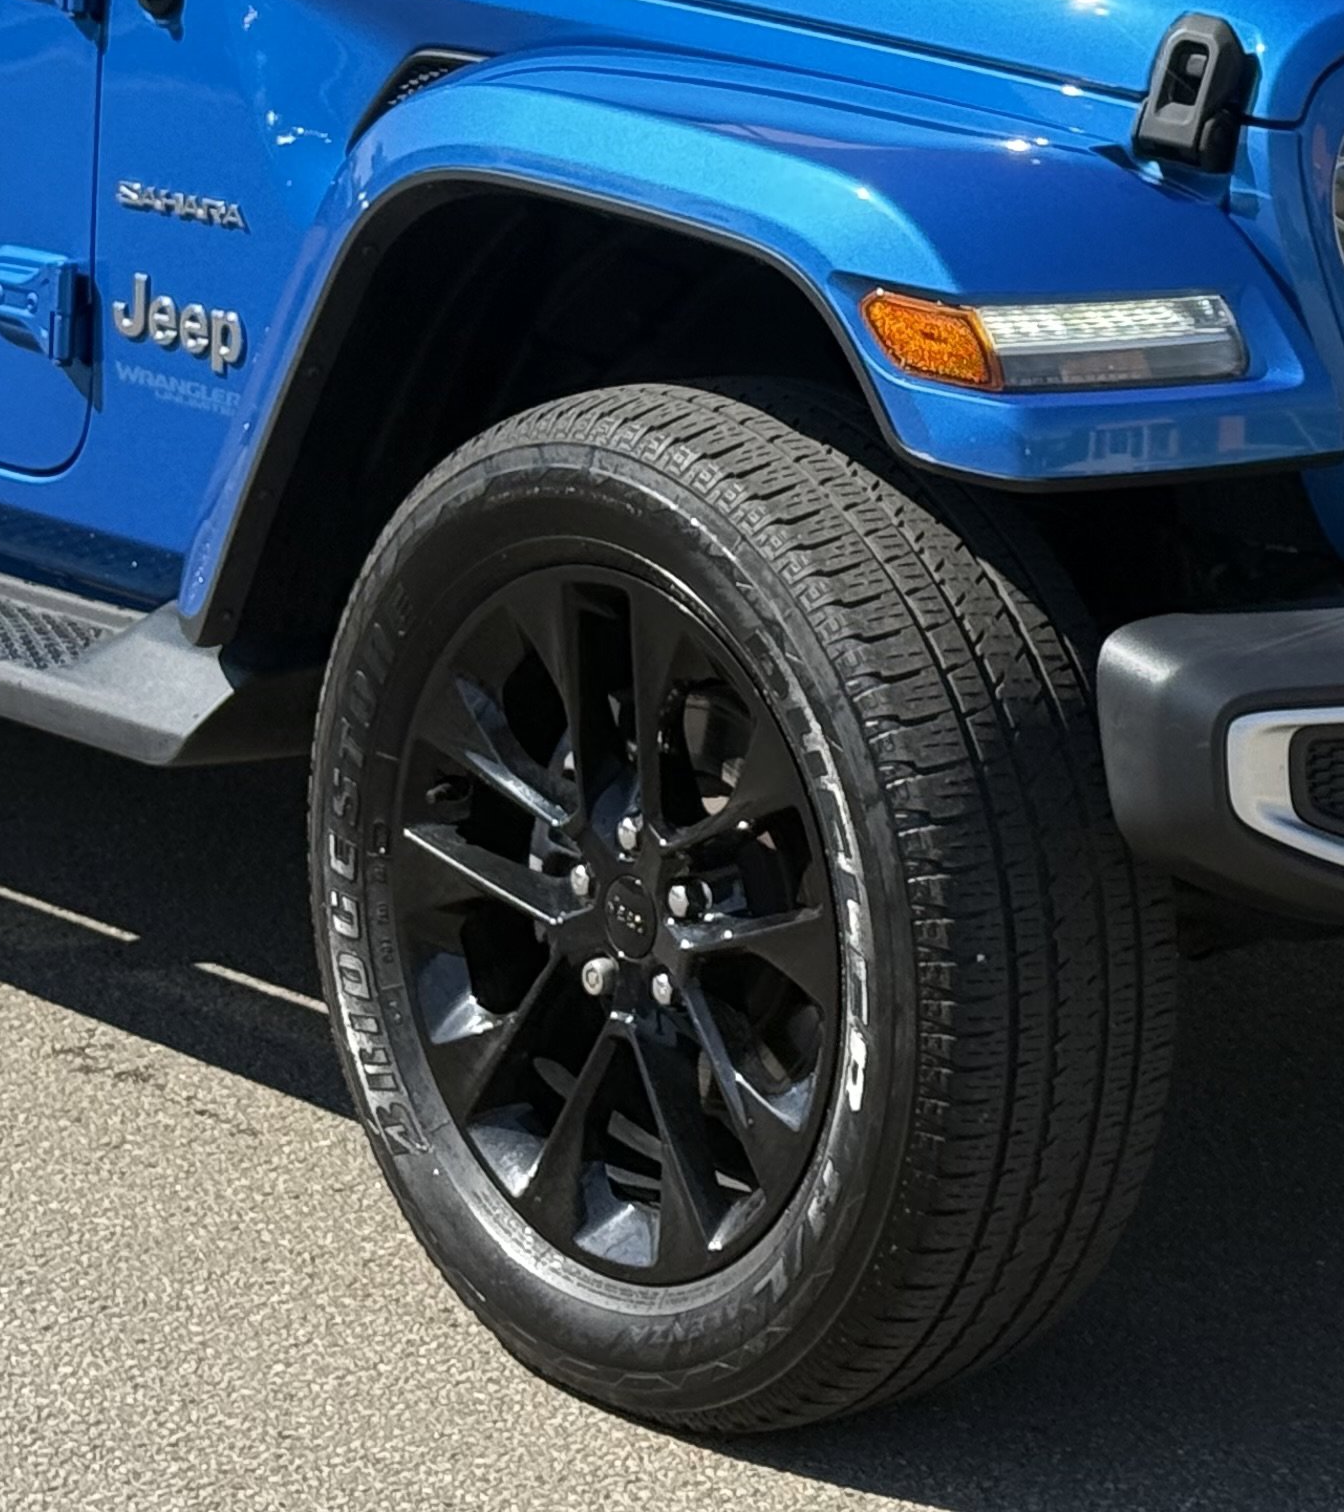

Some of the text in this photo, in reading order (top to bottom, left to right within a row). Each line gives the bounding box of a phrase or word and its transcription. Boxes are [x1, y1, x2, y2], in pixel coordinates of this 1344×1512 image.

[116, 180, 247, 231] SAHARA
[112, 272, 244, 374] Jeep
[115, 360, 242, 407] WRANGLER
[327, 581, 433, 1157] BRIDGESTONE
